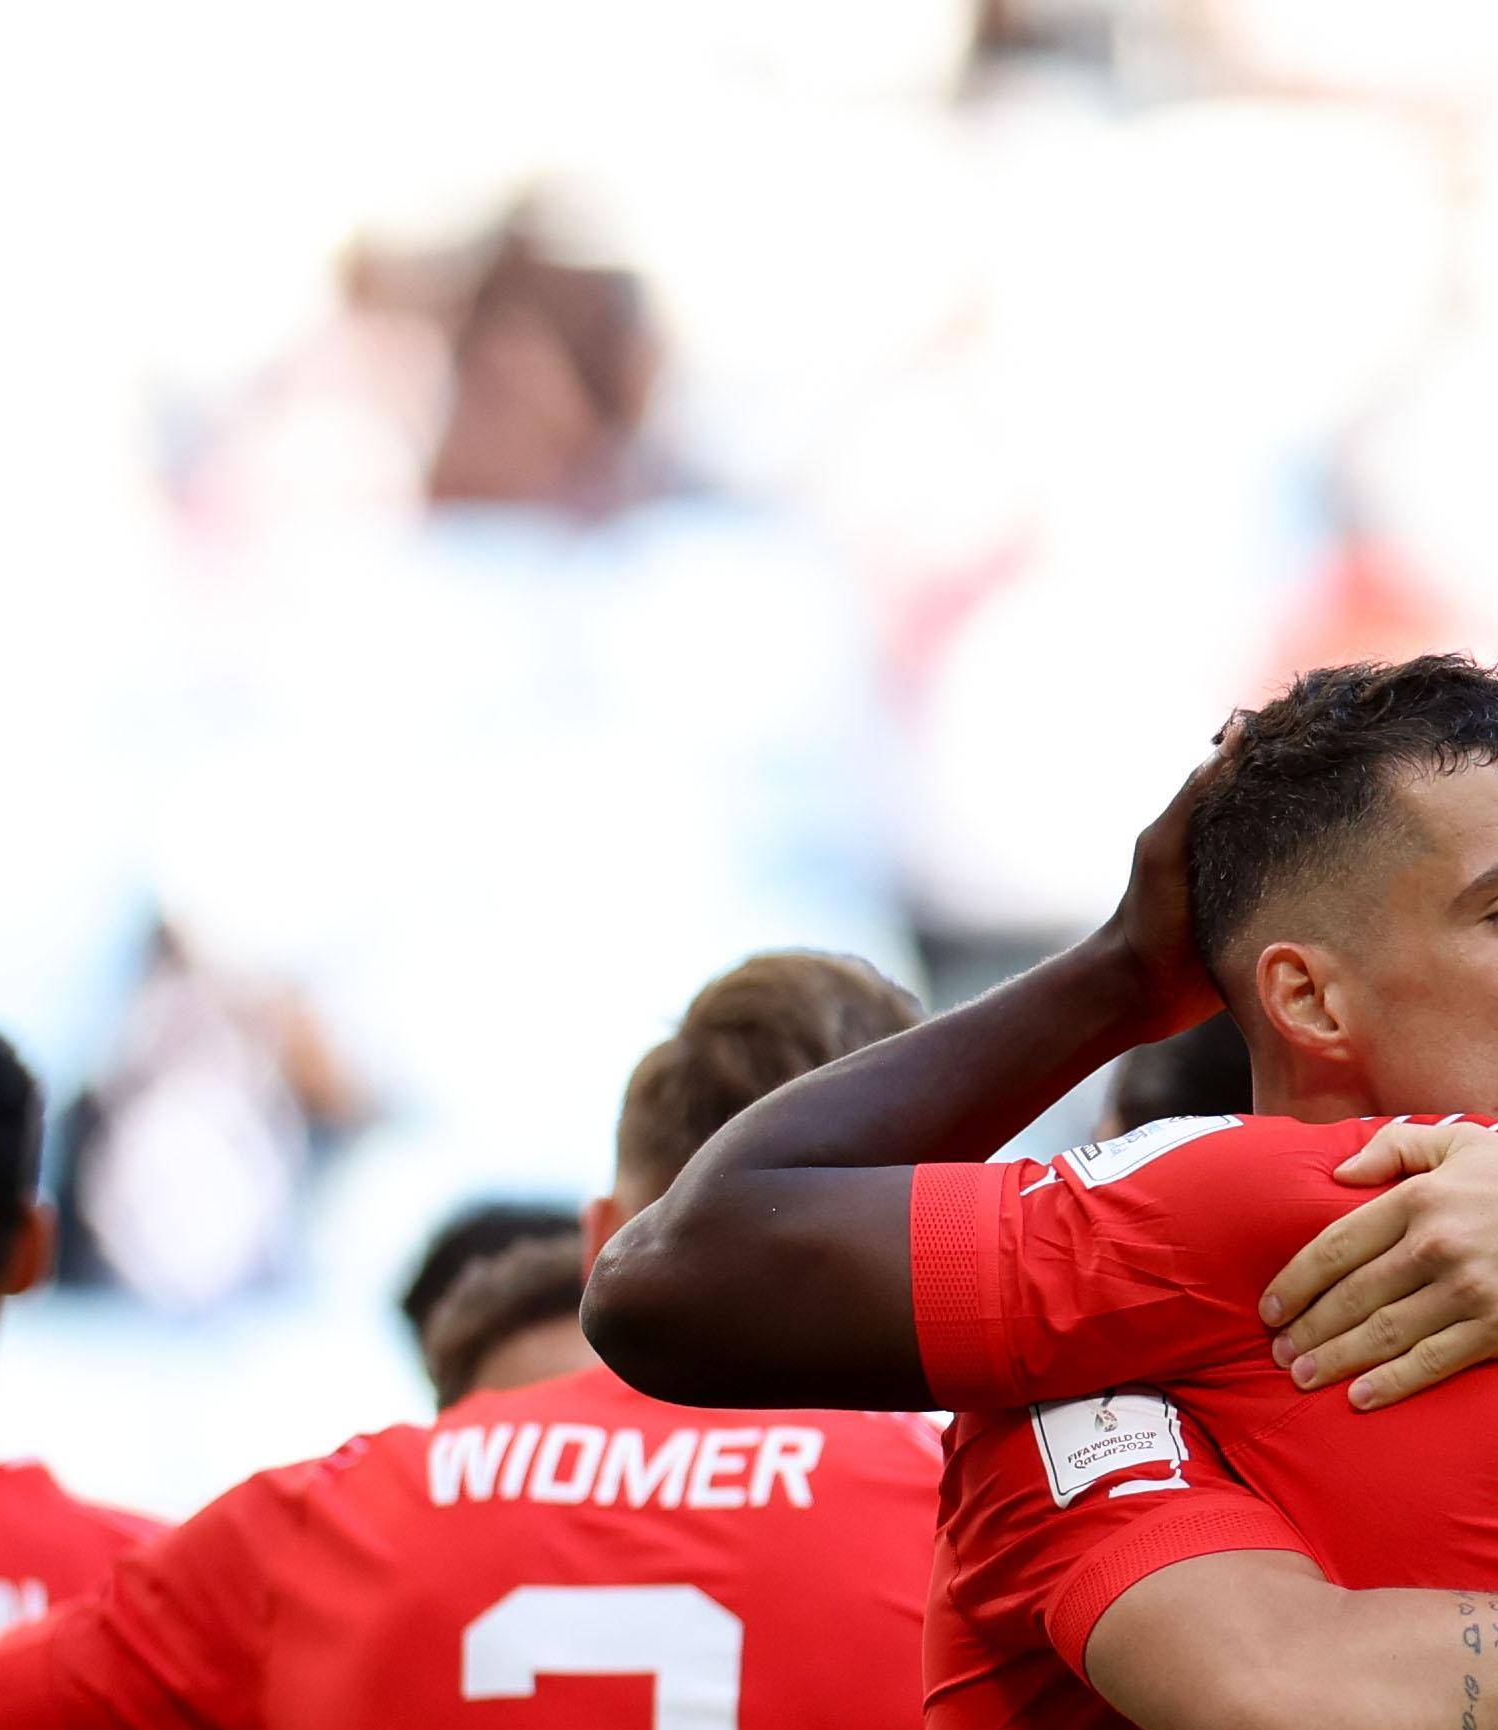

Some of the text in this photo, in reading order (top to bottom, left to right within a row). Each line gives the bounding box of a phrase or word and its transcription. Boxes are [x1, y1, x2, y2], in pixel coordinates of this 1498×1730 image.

[428, 1422, 825, 1508] WIDMER
[1067, 1431, 1157, 1463] FIFA WORLD CUP
